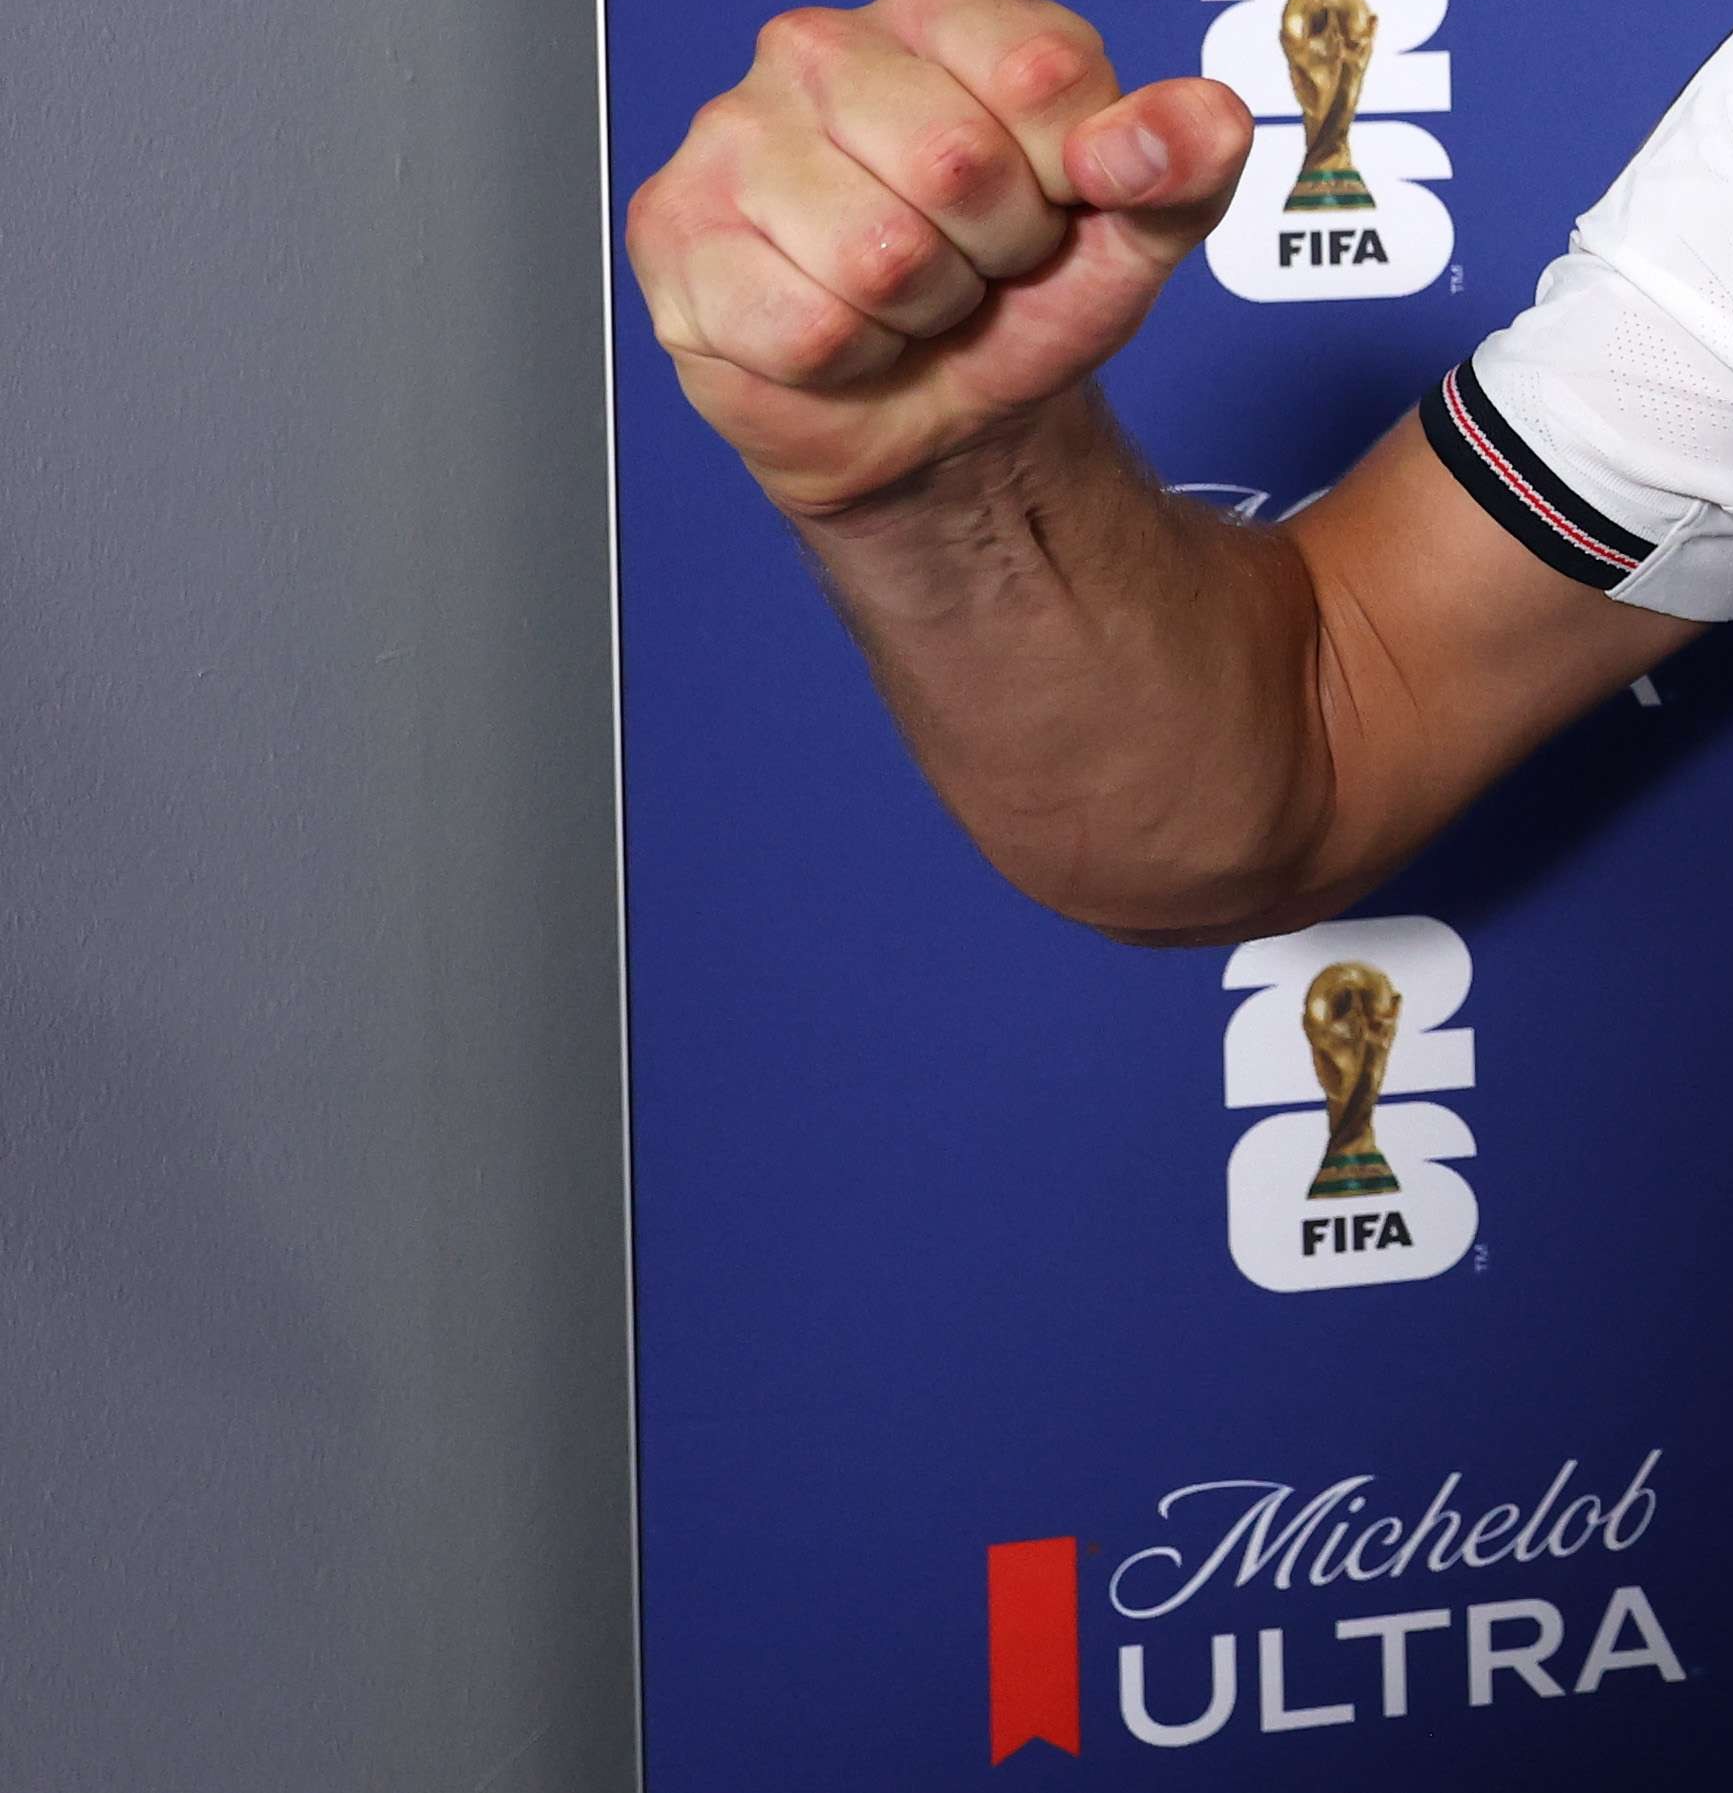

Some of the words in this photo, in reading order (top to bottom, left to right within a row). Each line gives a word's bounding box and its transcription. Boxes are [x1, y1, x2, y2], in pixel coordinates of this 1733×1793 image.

[1279, 230, 1389, 267] FIFA
[1302, 1212, 1413, 1256] FIFA
[1110, 1450, 1661, 1618] Michelob
[1119, 1587, 1685, 1747] ULTRA
